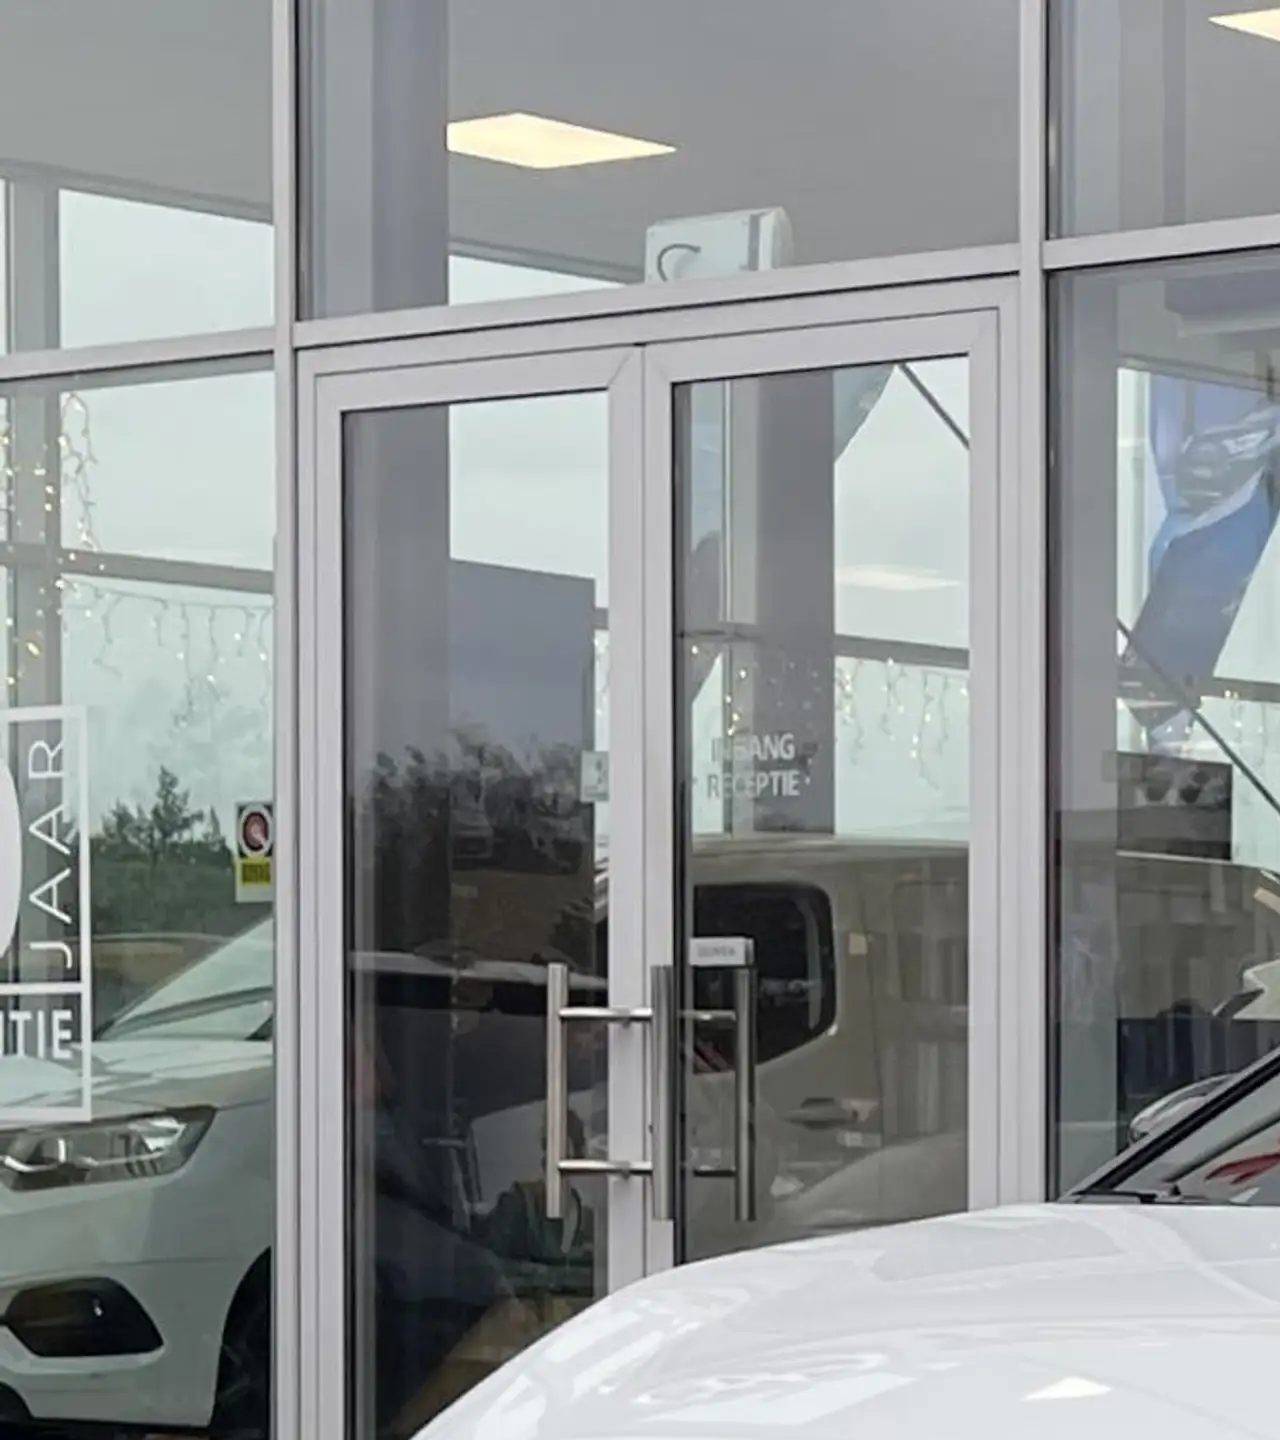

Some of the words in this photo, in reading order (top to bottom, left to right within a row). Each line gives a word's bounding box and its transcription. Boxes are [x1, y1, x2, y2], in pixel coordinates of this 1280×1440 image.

[707, 769, 801, 799] RECEPTIE
[28, 740, 72, 969] JAAR
[0, 1009, 73, 1060] TIE
